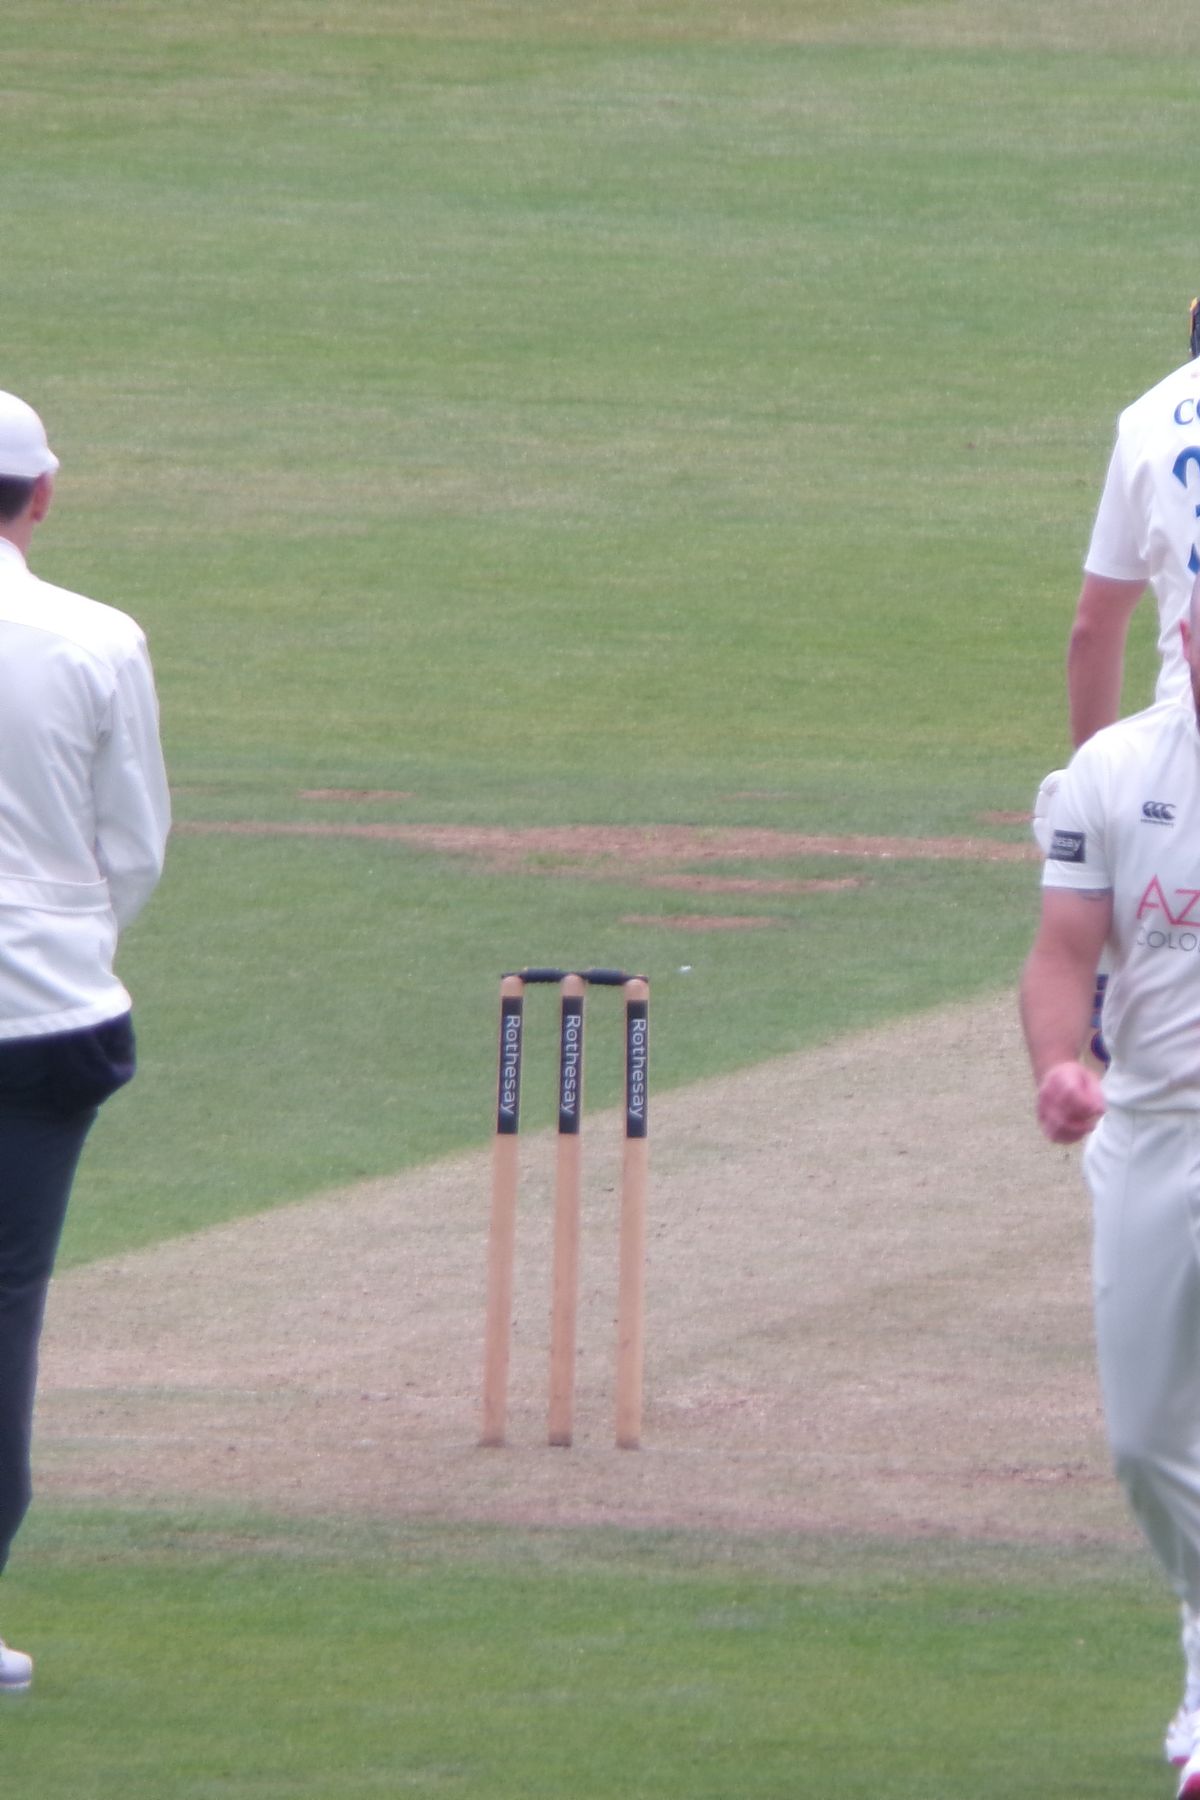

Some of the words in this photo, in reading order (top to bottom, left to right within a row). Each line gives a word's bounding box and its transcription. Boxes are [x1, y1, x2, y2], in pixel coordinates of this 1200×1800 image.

[500, 1014, 521, 1116] Rothesay
[560, 1014, 581, 1116] Rothesay
[629, 1018, 647, 1118] Rothesay
